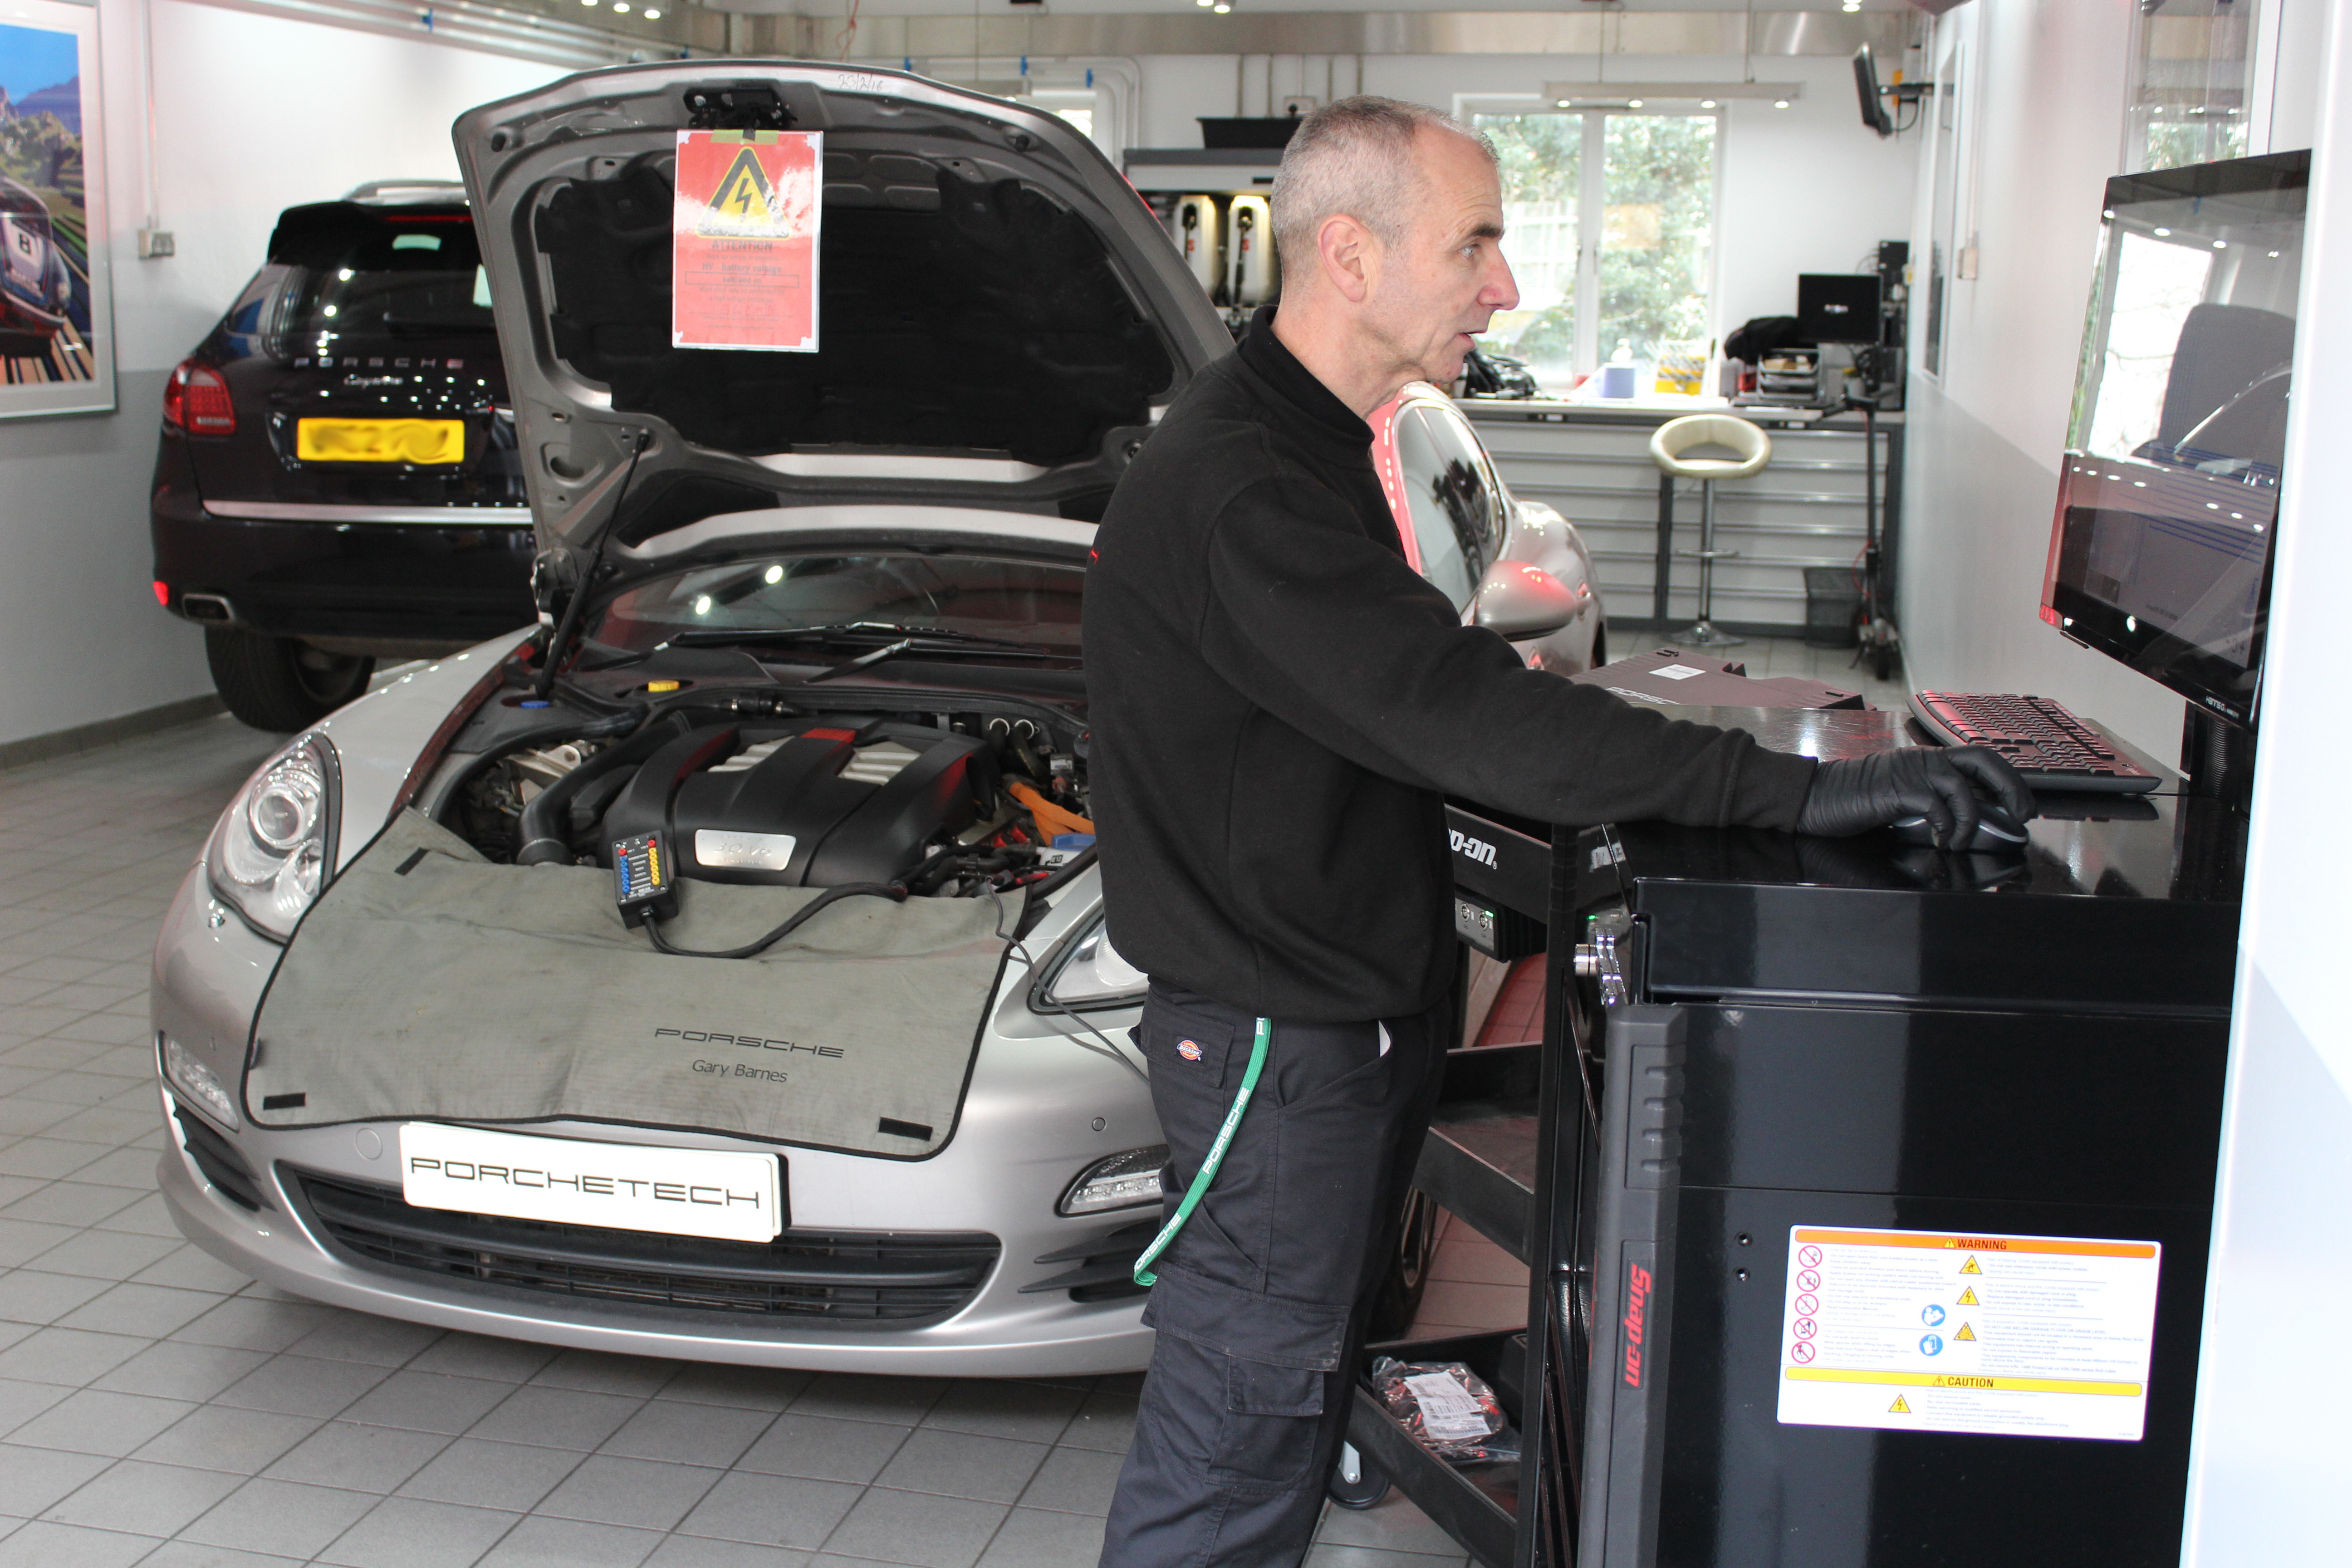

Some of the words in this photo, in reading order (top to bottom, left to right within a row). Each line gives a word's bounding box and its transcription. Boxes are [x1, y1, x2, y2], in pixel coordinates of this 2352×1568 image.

[711, 239, 773, 251] ATTENTION
[721, 263, 750, 274] battery
[753, 265, 782, 275] voltage
[294, 357, 463, 369] PORSCHE
[1605, 686, 1680, 705] PORSC
[1448, 828, 1497, 867] p-on
[655, 1028, 844, 1058] PORSCHE
[692, 1059, 730, 1077] Gary
[735, 1063, 788, 1083] Barnes
[1203, 1087, 1250, 1174] PORSCHE
[411, 1157, 760, 1209] PORCHETECH
[1958, 1239, 2007, 1250] WARNING
[1624, 1263, 1651, 1387] Snap-on
[1948, 1377, 1994, 1387] CAUTION
